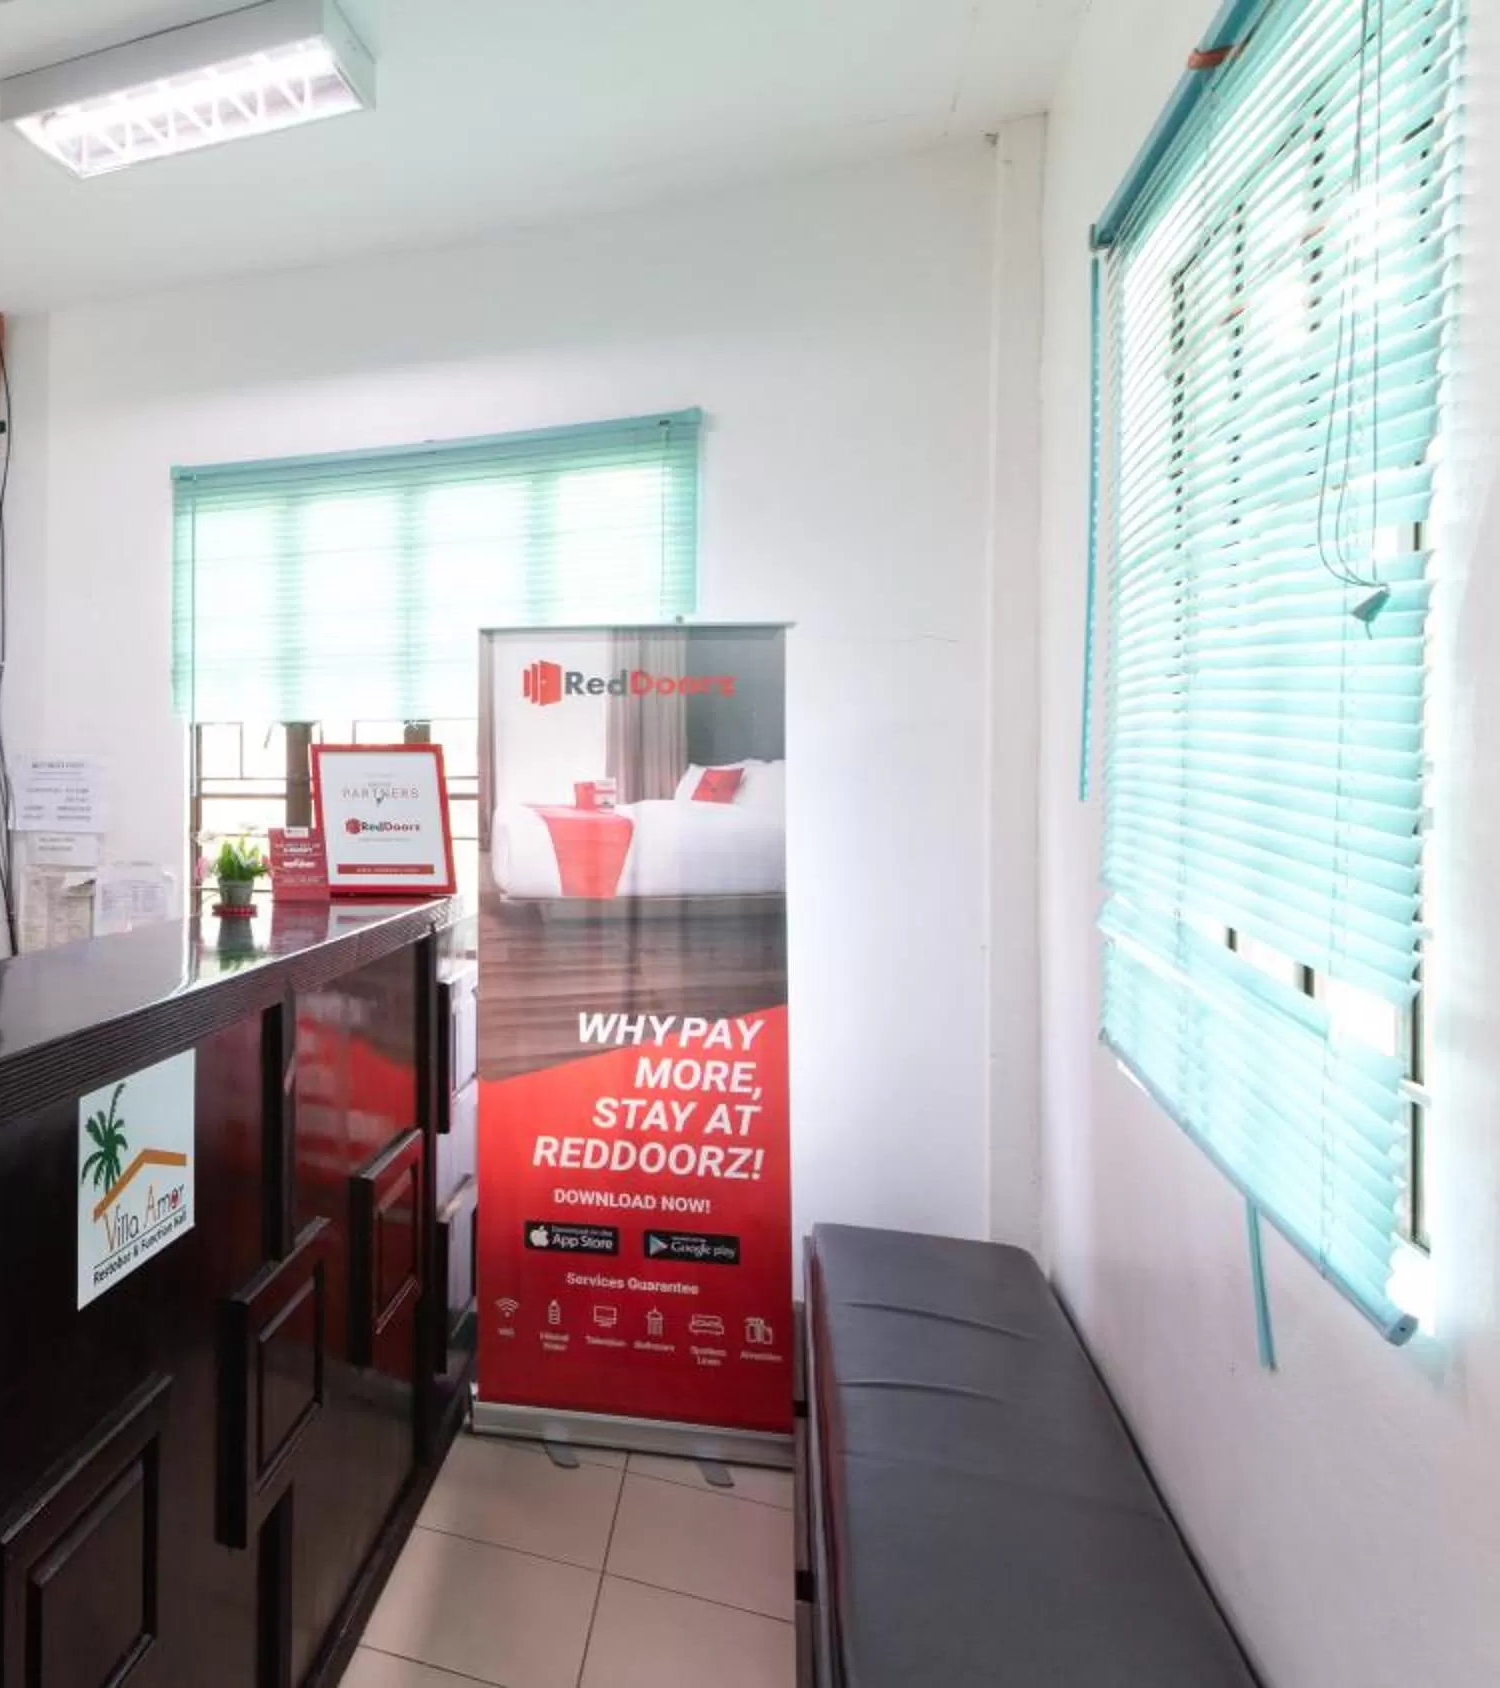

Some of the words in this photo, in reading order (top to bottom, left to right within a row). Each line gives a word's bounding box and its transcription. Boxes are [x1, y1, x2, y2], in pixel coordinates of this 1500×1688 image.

[565, 669, 738, 697] RedDoorz
[342, 787, 419, 799] PARTNERS
[578, 1012, 674, 1044] WHY
[679, 1017, 766, 1051] PAY
[635, 1057, 762, 1100] MORE,
[593, 1098, 697, 1133] STAY
[704, 1104, 761, 1136] AT
[533, 1136, 766, 1180] REDDOORZ!
[554, 1188, 656, 1210] DOWNLOAD
[661, 1195, 711, 1213] NOW!
[103, 1203, 139, 1252] Villa
[552, 1234, 579, 1250] App
[579, 1235, 613, 1250] Store
[671, 1241, 710, 1258] Google
[713, 1247, 736, 1260] play
[566, 1272, 625, 1290] Services
[628, 1276, 699, 1295] Guarantee
